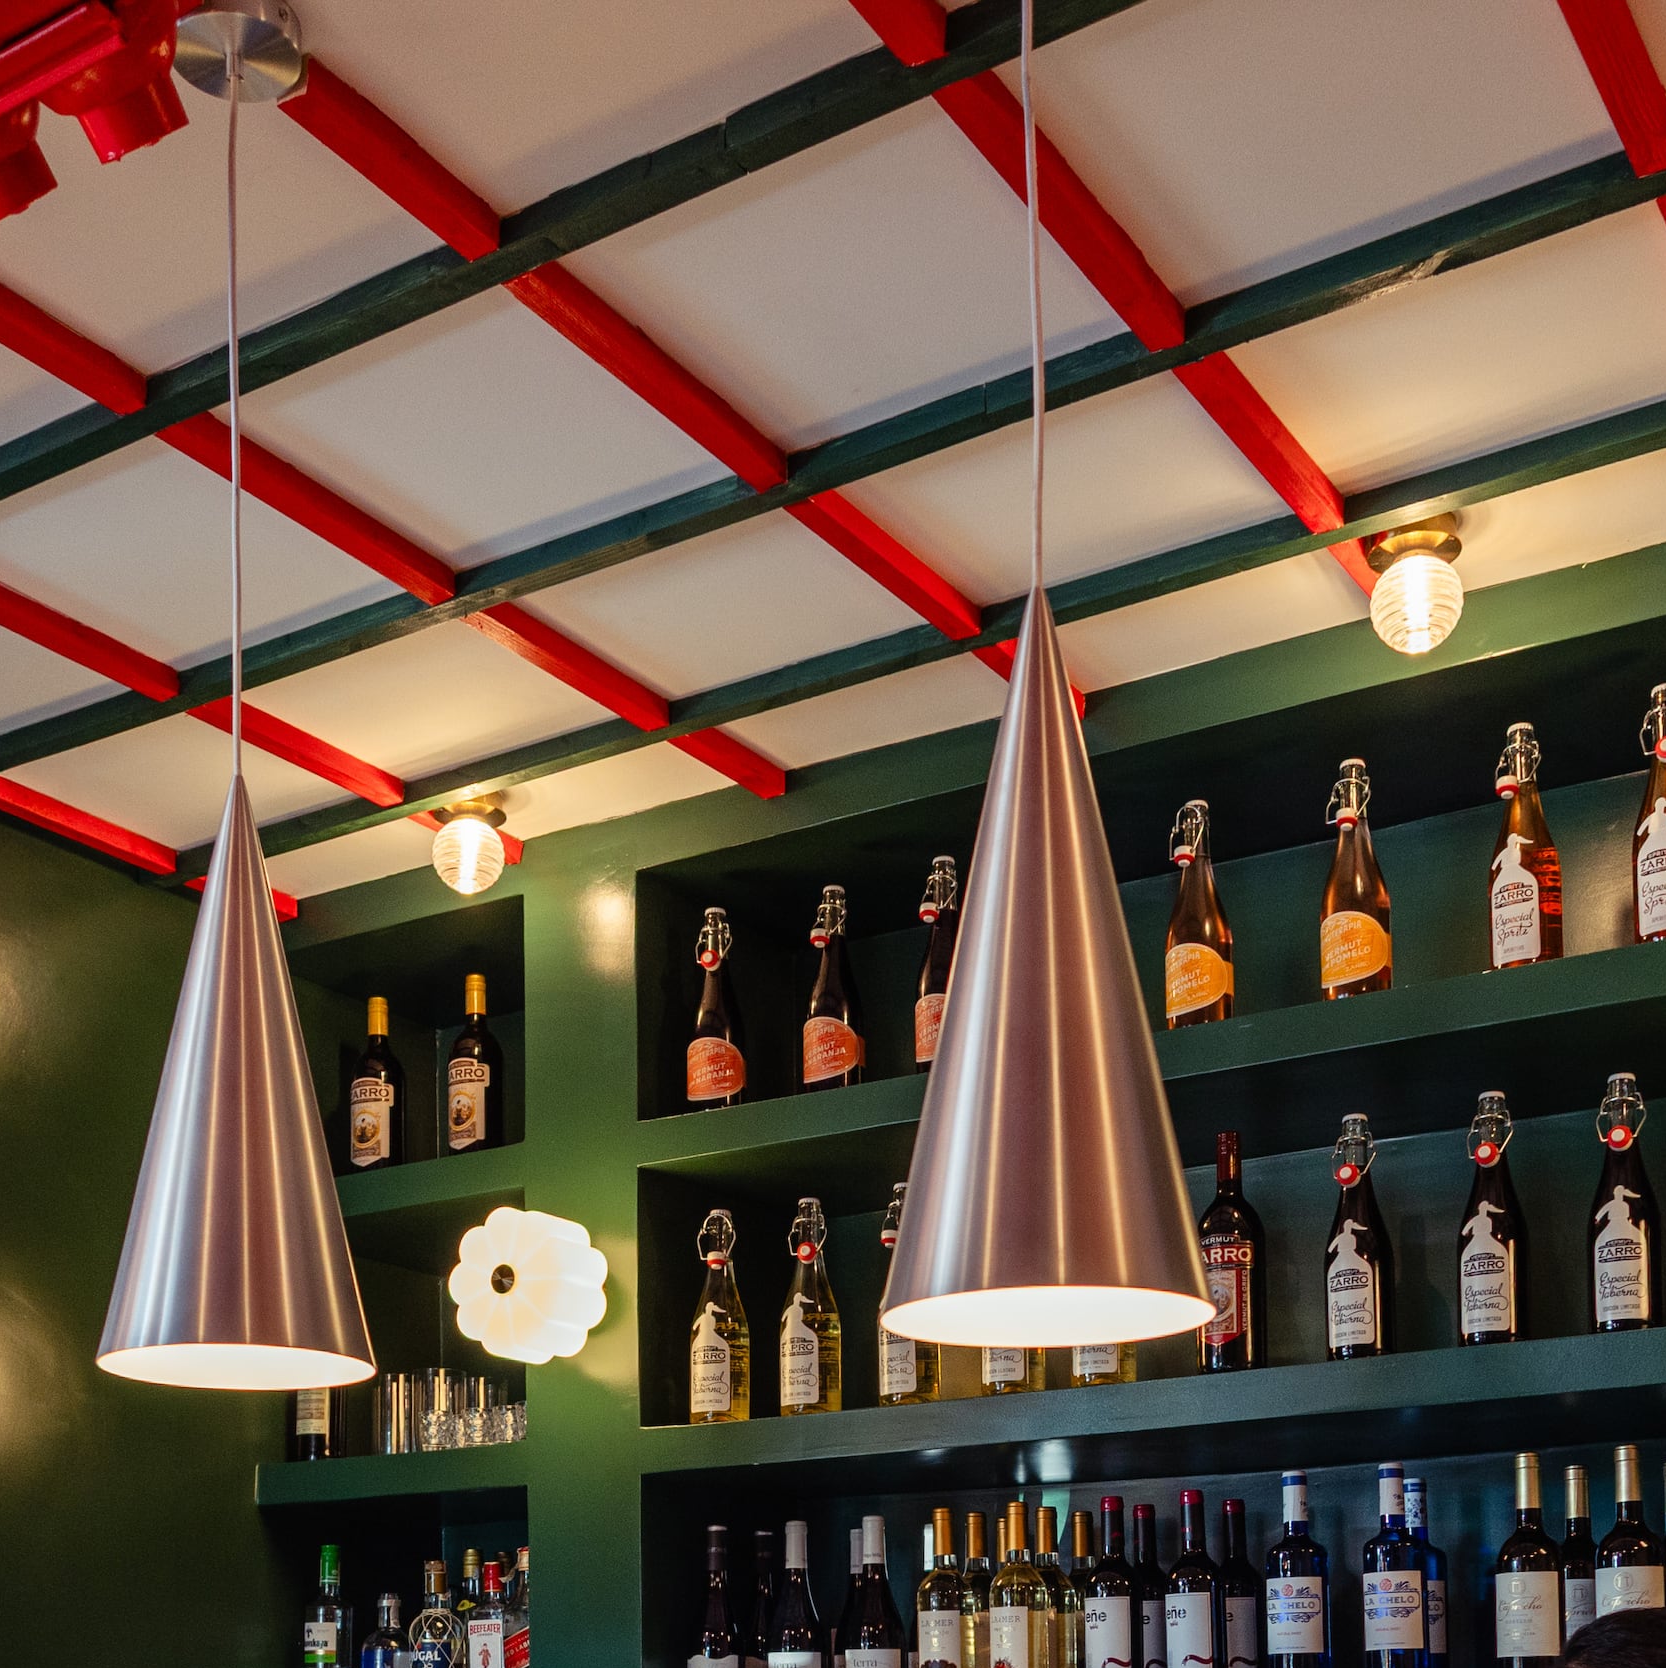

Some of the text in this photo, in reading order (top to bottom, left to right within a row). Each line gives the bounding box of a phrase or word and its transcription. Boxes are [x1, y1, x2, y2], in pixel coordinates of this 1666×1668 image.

[1494, 888, 1533, 905] ZARRO
[1495, 907, 1534, 930] Especial
[1497, 922, 1533, 946] Spritz
[1330, 946, 1371, 967] POMELO
[448, 1067, 485, 1080] ARRO
[696, 1069, 735, 1084] NARANJA
[352, 1087, 390, 1099] ARRO
[1201, 1236, 1235, 1246] VERMUT
[1201, 1247, 1252, 1264] ARRO
[1598, 1246, 1642, 1258] ZARRO
[1463, 1260, 1505, 1273] ZARRO
[1330, 1275, 1368, 1288] ZARRO
[1600, 1269, 1642, 1288] Especial
[1465, 1282, 1503, 1300] Especial
[1599, 1283, 1646, 1301] Taberna
[1464, 1296, 1509, 1312] Taberna
[693, 1352, 726, 1362] ZARRO
[1281, 1600, 1316, 1610] CHELO
[1379, 1595, 1415, 1605] CHELO
[469, 1623, 501, 1635] BEEFEATER
[413, 1651, 441, 1661] UGAL
[853, 1659, 878, 1668] terra
